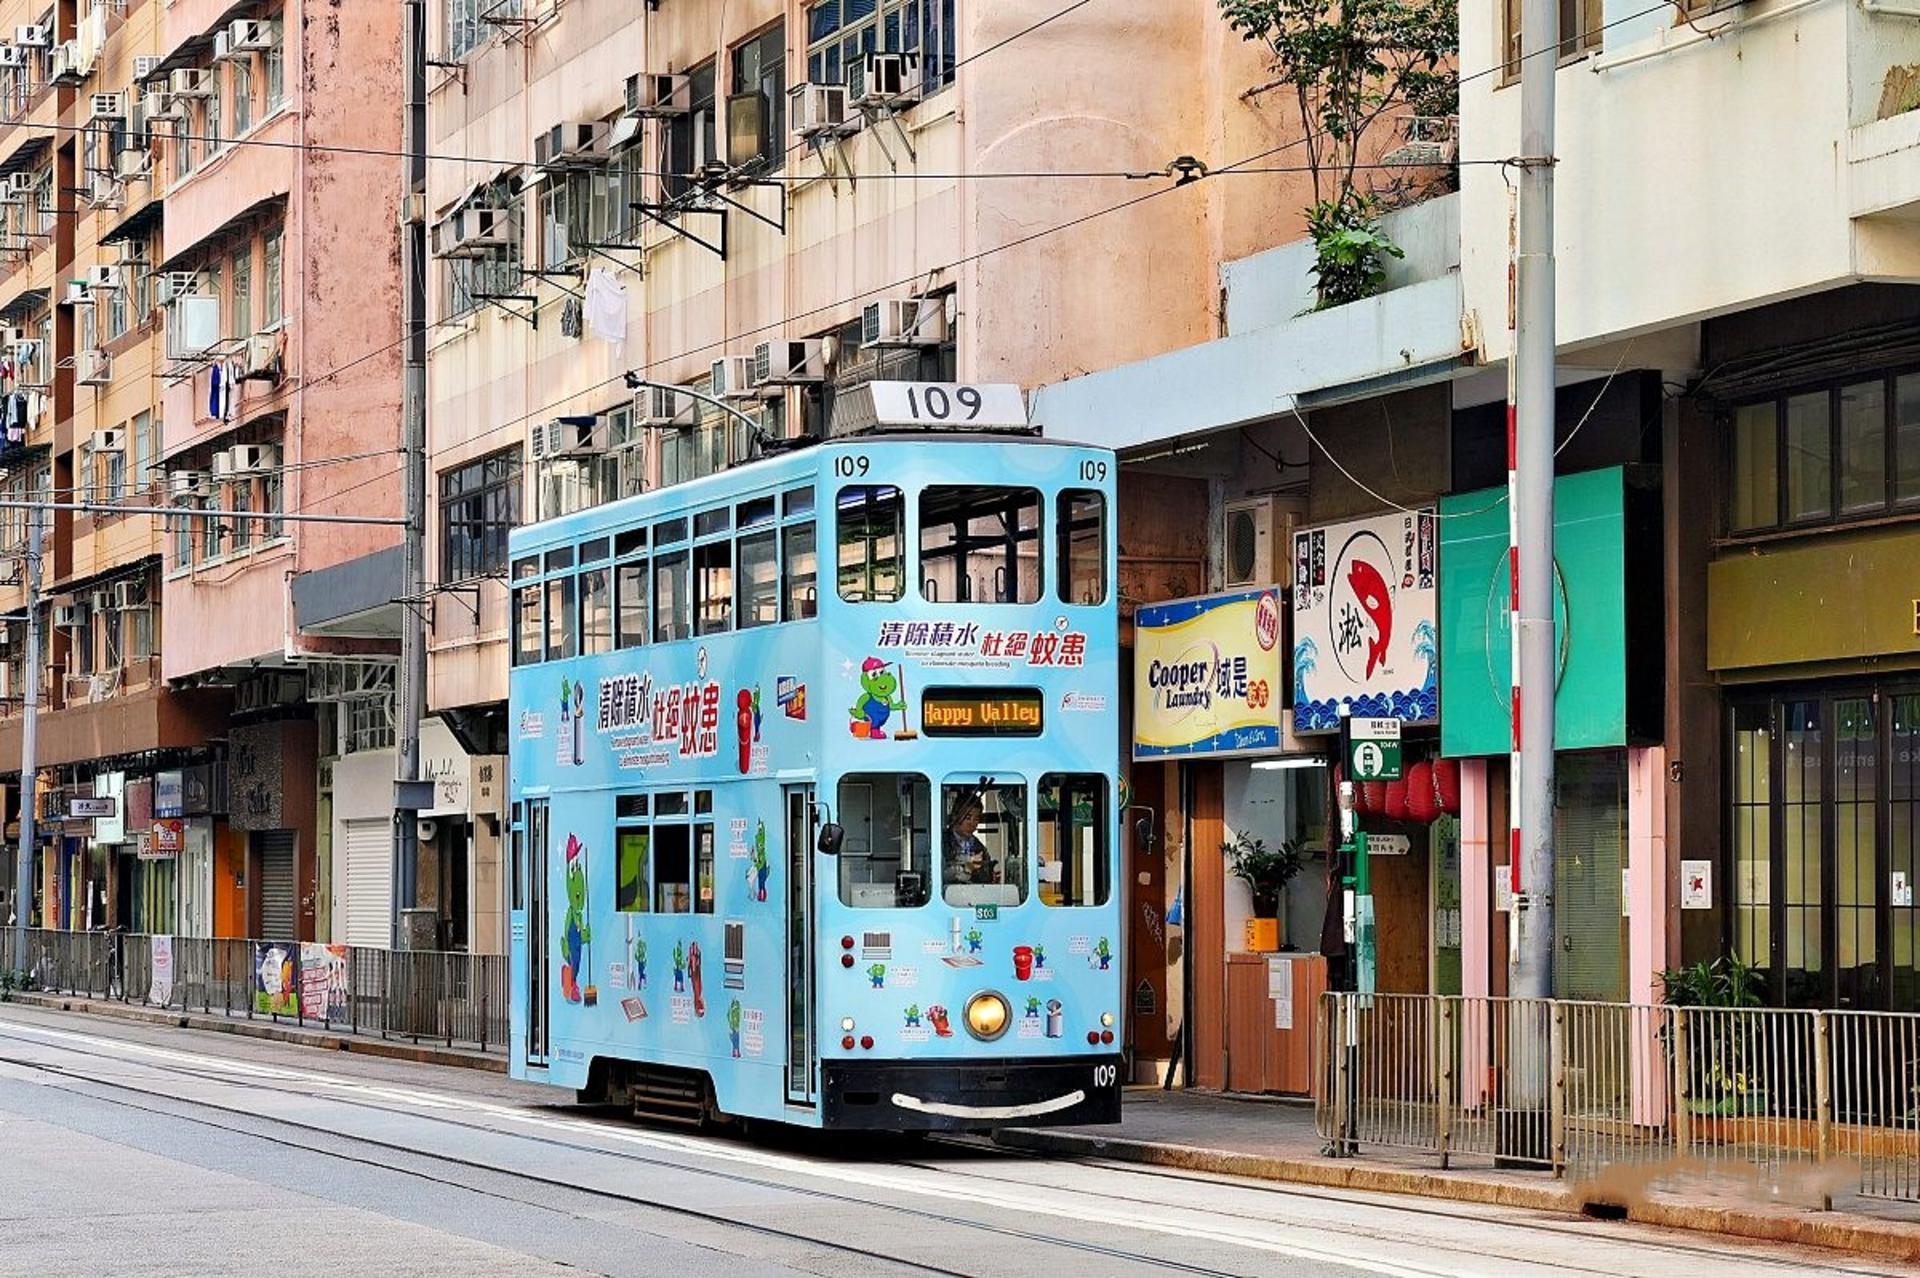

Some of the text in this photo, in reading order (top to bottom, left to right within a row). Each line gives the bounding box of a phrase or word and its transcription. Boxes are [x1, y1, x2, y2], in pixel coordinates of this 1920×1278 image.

[907, 386, 982, 420] 109
[835, 456, 870, 477] 109
[1080, 460, 1107, 482] 109
[877, 621, 1086, 665] 清除積水 杜絕蚊患
[1148, 659, 1208, 691] Cooper
[1166, 686, 1211, 710] Laundry
[597, 674, 652, 730] 清除積水
[652, 682, 719, 754] 杜絕蚊患
[924, 702, 1040, 726] Happy Valley
[1093, 1065, 1116, 1087] 109
